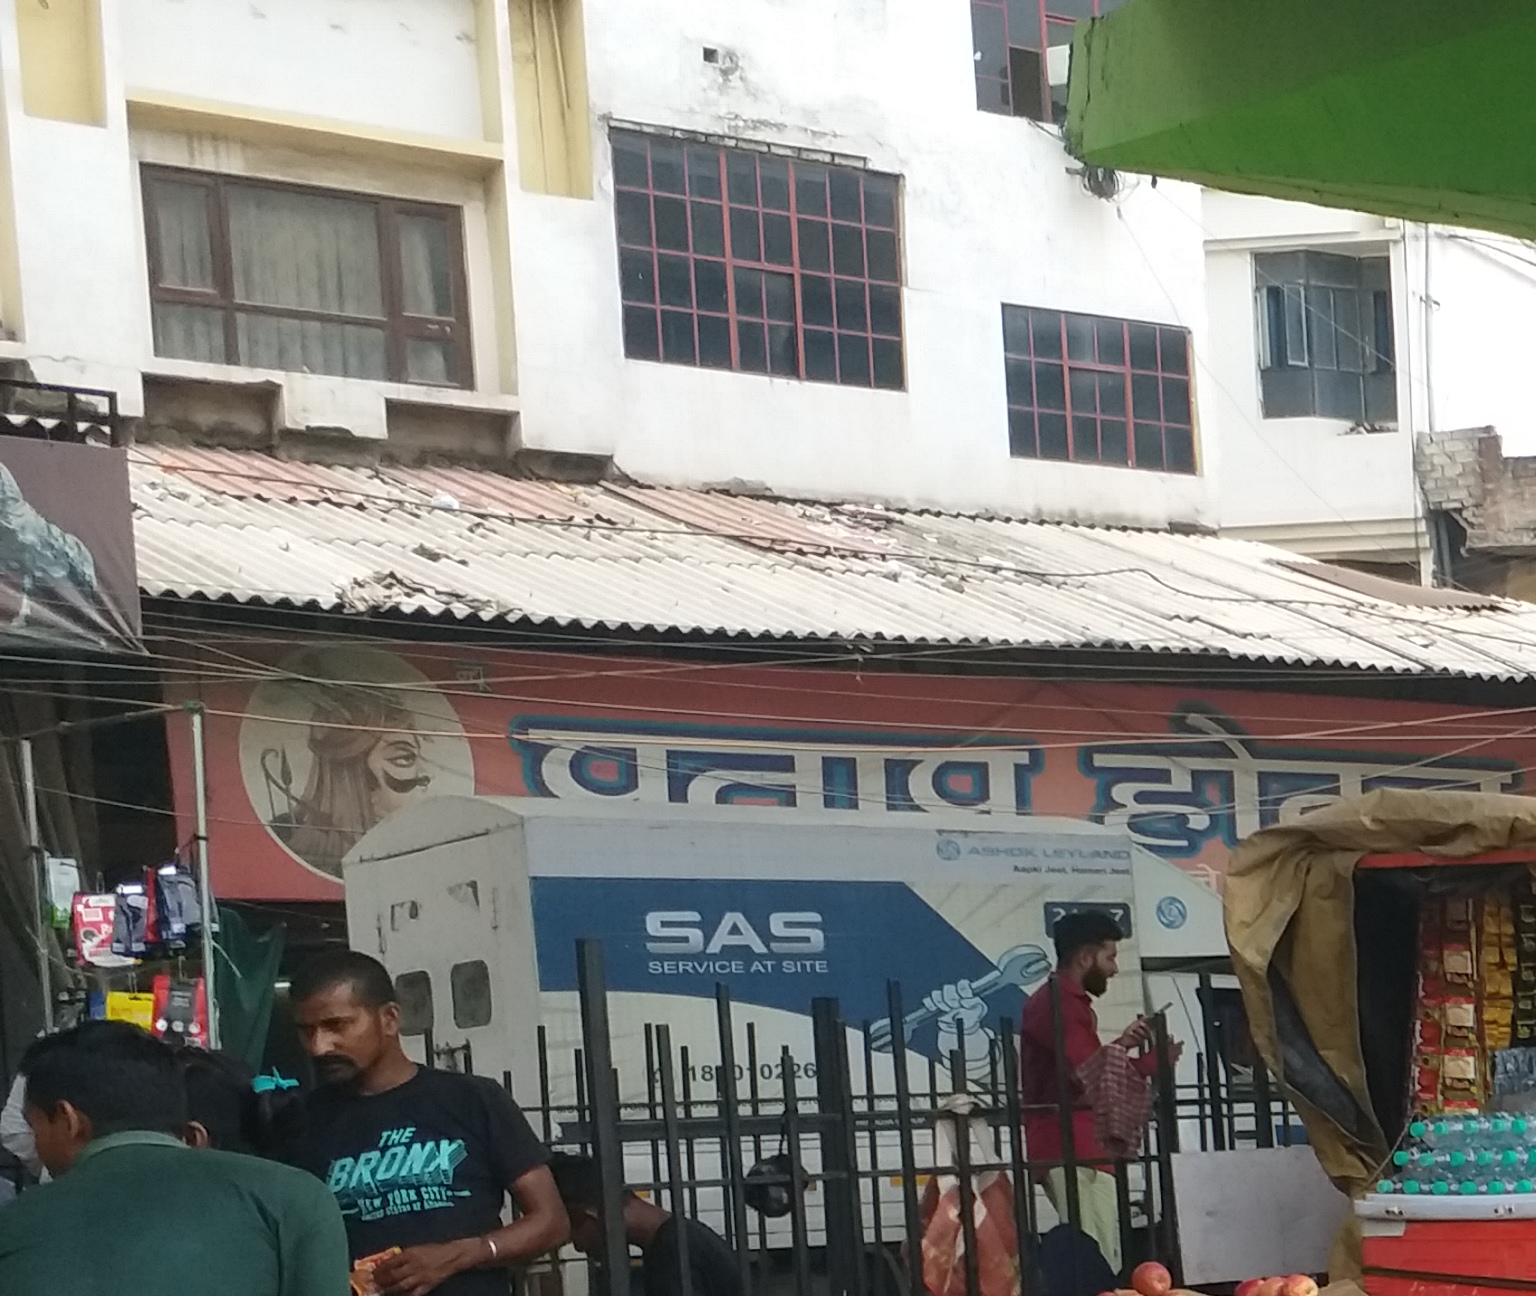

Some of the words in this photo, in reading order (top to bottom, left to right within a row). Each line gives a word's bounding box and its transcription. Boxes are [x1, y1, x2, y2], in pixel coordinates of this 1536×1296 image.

[967, 845, 1036, 859] ASHOK
[1043, 848, 1131, 860] LEYLAND
[645, 911, 825, 954] SAS
[648, 960, 745, 974] SERVICE
[750, 960, 776, 974] AT
[782, 960, 829, 974] SITE
[378, 1127, 416, 1147] THE
[328, 1139, 467, 1194] BRONX
[387, 1189, 418, 1206] YORK
[420, 1186, 447, 1201] CITY
